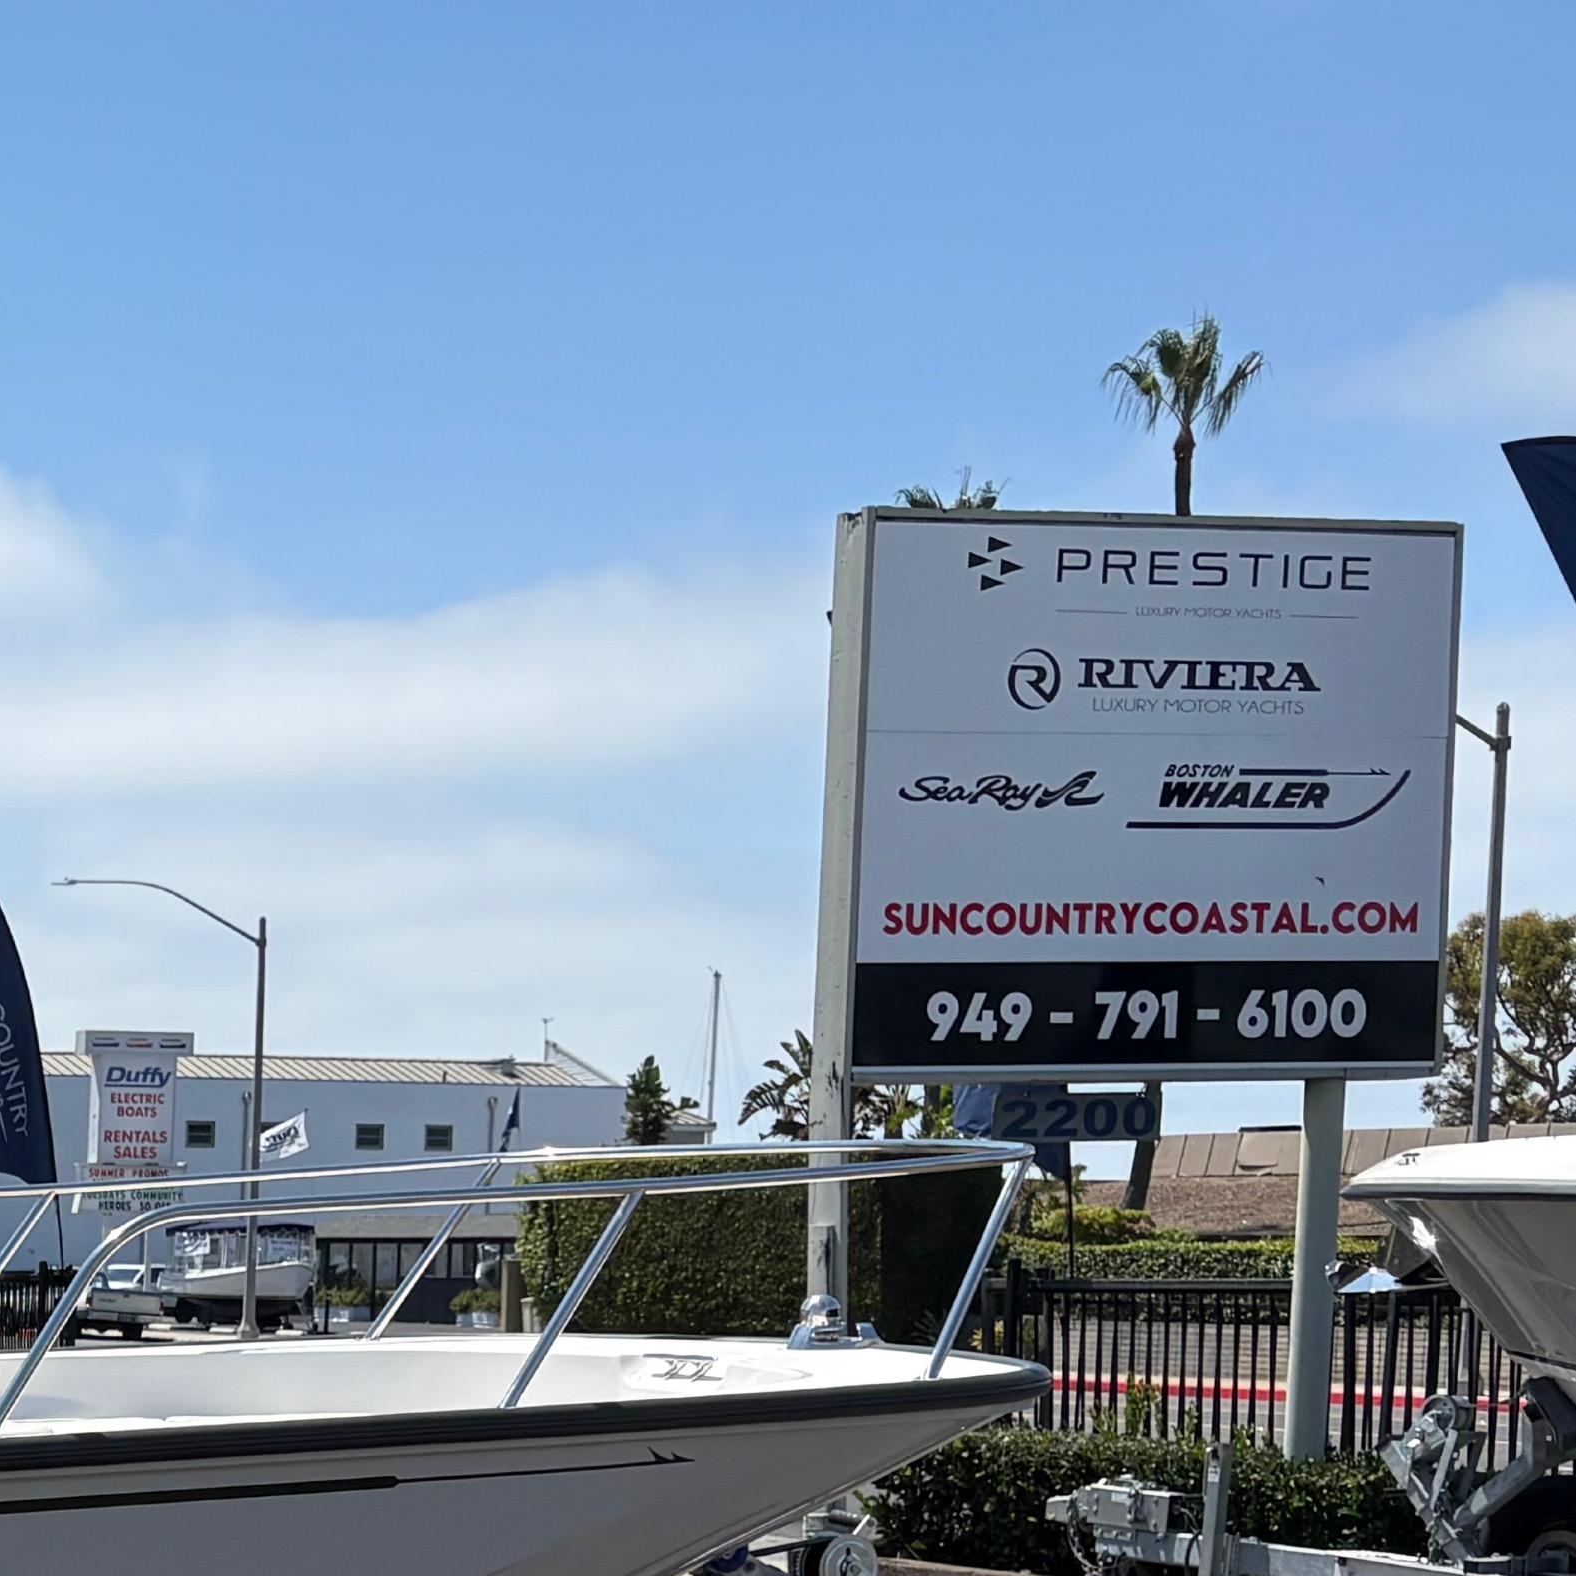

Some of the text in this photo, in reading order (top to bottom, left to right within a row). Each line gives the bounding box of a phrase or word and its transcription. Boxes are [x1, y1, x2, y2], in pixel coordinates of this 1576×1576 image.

[1056, 548, 1372, 591] PRESTIGE
[1135, 606, 1282, 620] LUXURY MOTOR YACHTS
[1077, 657, 1322, 692] RIVIERA
[1092, 698, 1304, 715] LUXURY MOTOR YACHTS
[1164, 763, 1235, 779] BOSTON
[1158, 781, 1331, 809] WHALER
[882, 900, 1418, 936] SUNCOUNTRYCOASTAL.COM
[104, 1066, 172, 1089] Duffy
[110, 1092, 165, 1104] ELECTRIC
[116, 1106, 158, 1118] BOATS
[1002, 1099, 1157, 1138] 2200
[103, 1130, 168, 1144] RENTALS
[113, 1146, 158, 1159] SALES
[88, 1167, 126, 1178] SUMMER
[130, 1190, 184, 1201] COMMUNITY
[98, 1201, 132, 1211] HEROES
